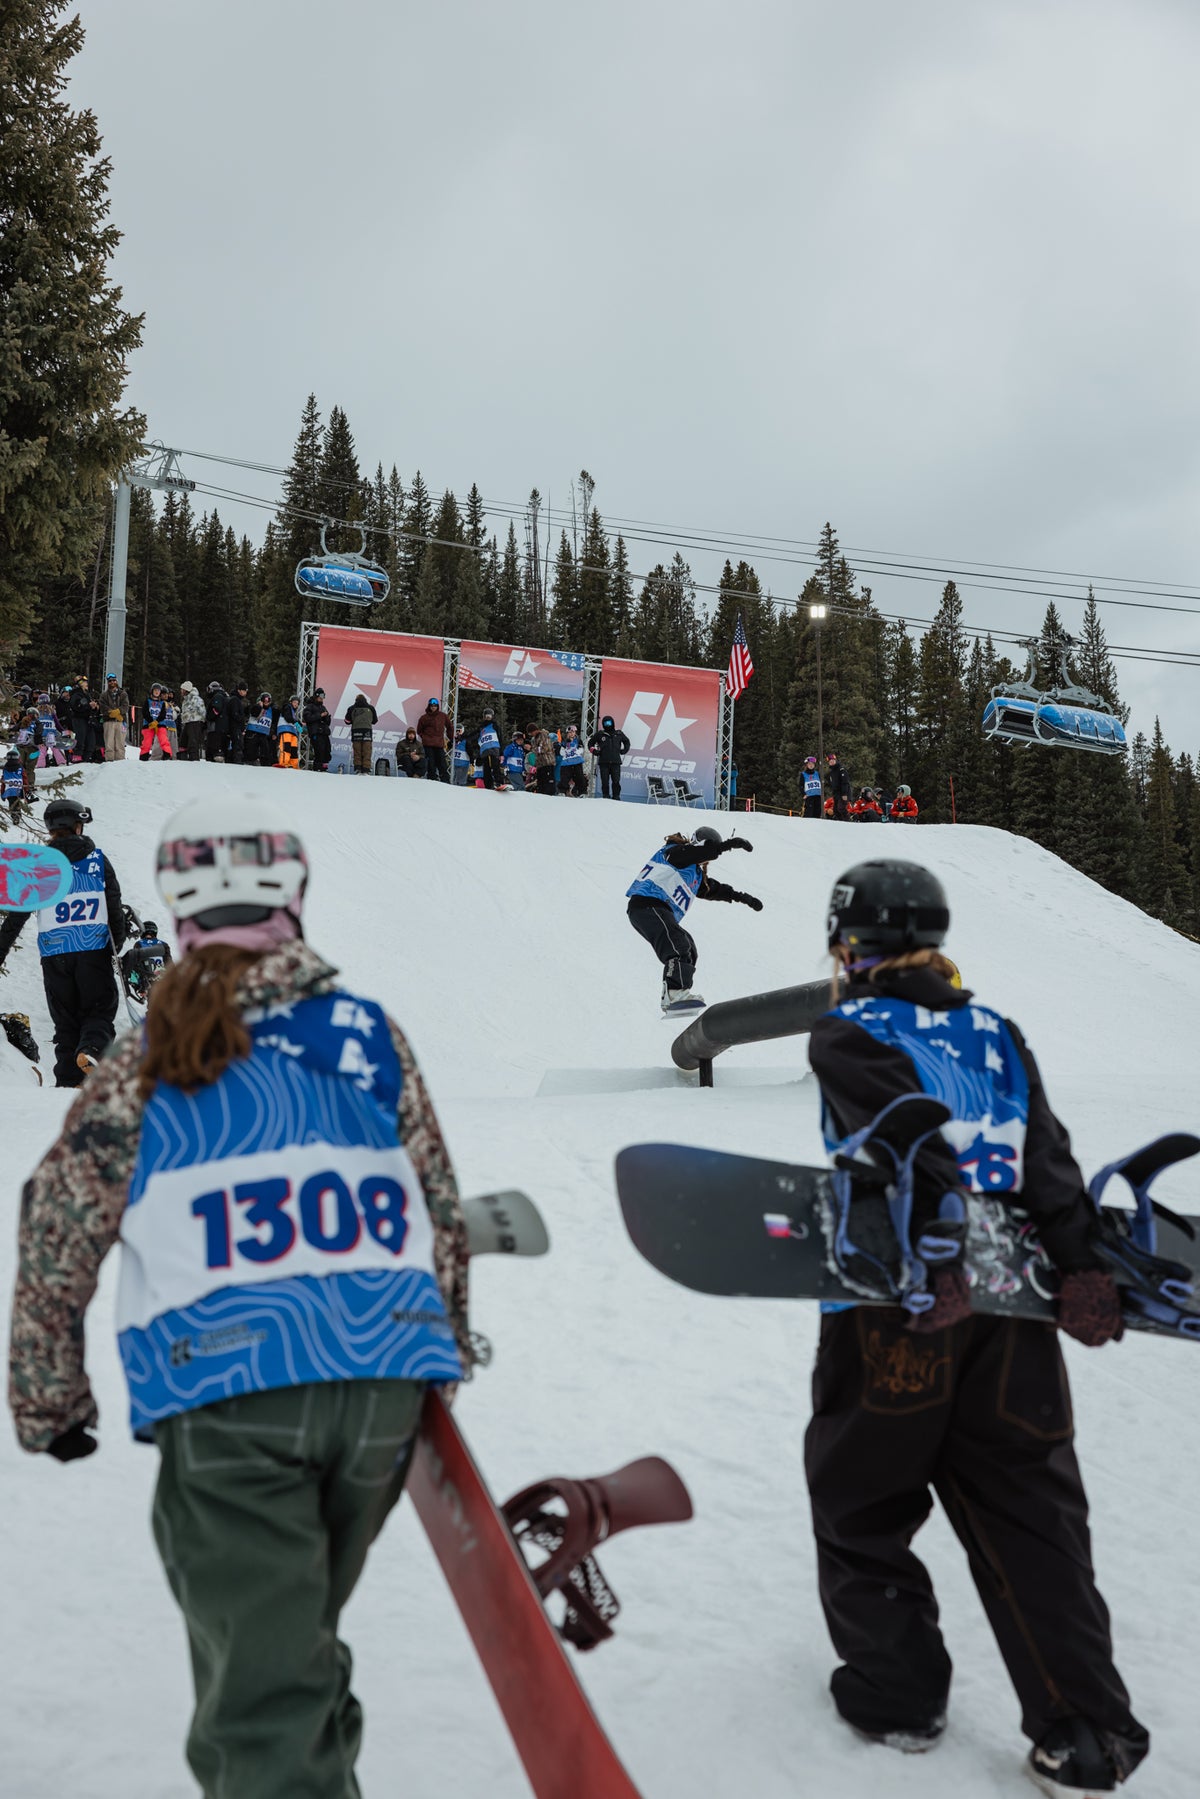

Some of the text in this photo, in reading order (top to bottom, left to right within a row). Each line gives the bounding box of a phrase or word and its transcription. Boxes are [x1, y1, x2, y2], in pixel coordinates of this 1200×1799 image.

[502, 677, 541, 688] usasa
[55, 898, 99, 923] 927
[190, 1171, 409, 1270] 1308
